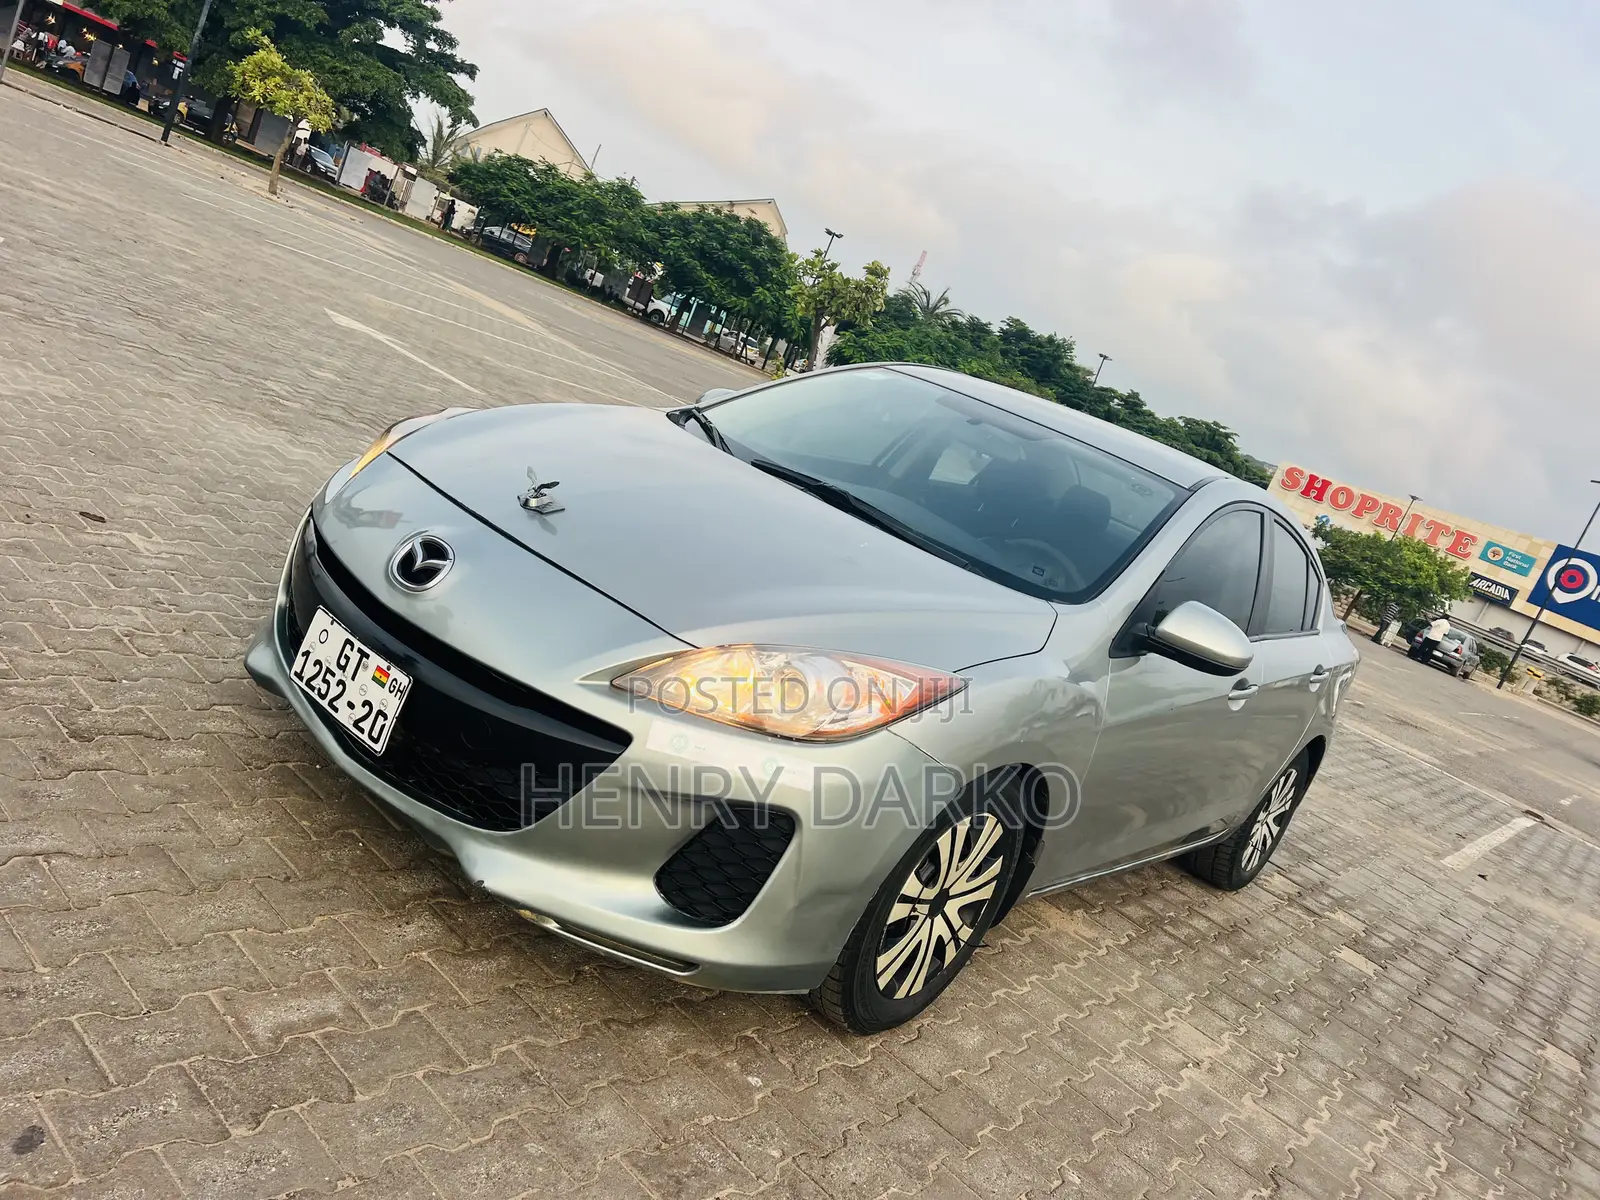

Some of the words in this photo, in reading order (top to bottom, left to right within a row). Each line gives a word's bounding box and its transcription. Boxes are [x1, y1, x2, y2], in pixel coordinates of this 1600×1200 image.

[1280, 466, 1478, 560] SHOPRITE
[1503, 561, 1518, 570] Bank
[1505, 556, 1530, 568] National
[1508, 551, 1522, 560] First
[1469, 578, 1510, 601] ARCADIA
[336, 638, 371, 682] GT
[293, 650, 388, 745] 1252-20
[388, 677, 406, 701] GH
